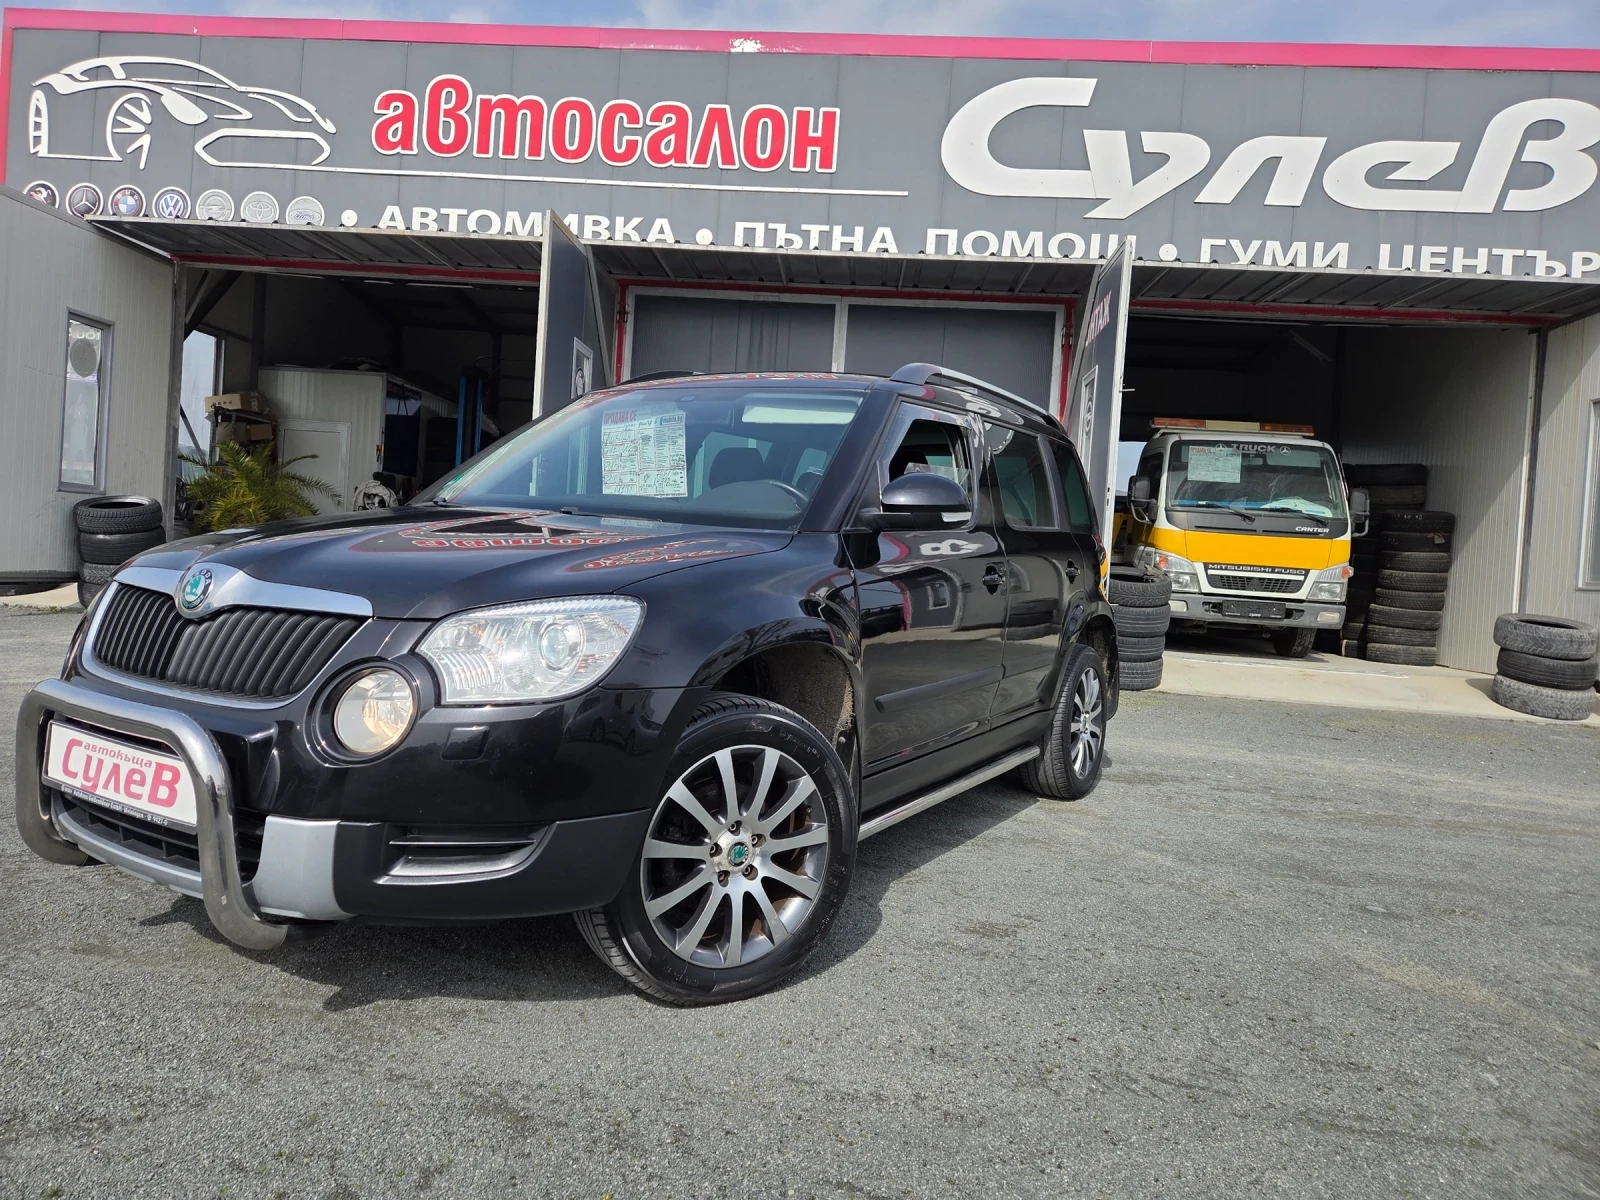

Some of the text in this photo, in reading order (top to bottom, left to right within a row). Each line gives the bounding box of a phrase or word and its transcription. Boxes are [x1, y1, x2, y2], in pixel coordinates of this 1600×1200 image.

[371, 74, 841, 173] автосалон
[941, 76, 1600, 219] Сулев
[734, 221, 899, 254] ПЪТНА
[1199, 237, 1350, 269] ГУМИ
[1378, 243, 1600, 279] ЦЕНТЪР
[1231, 443, 1277, 453] TRUCK
[1295, 526, 1330, 534] CANTER
[1208, 563, 1272, 572] MITSUBISHI
[83, 742, 153, 769] автокъща
